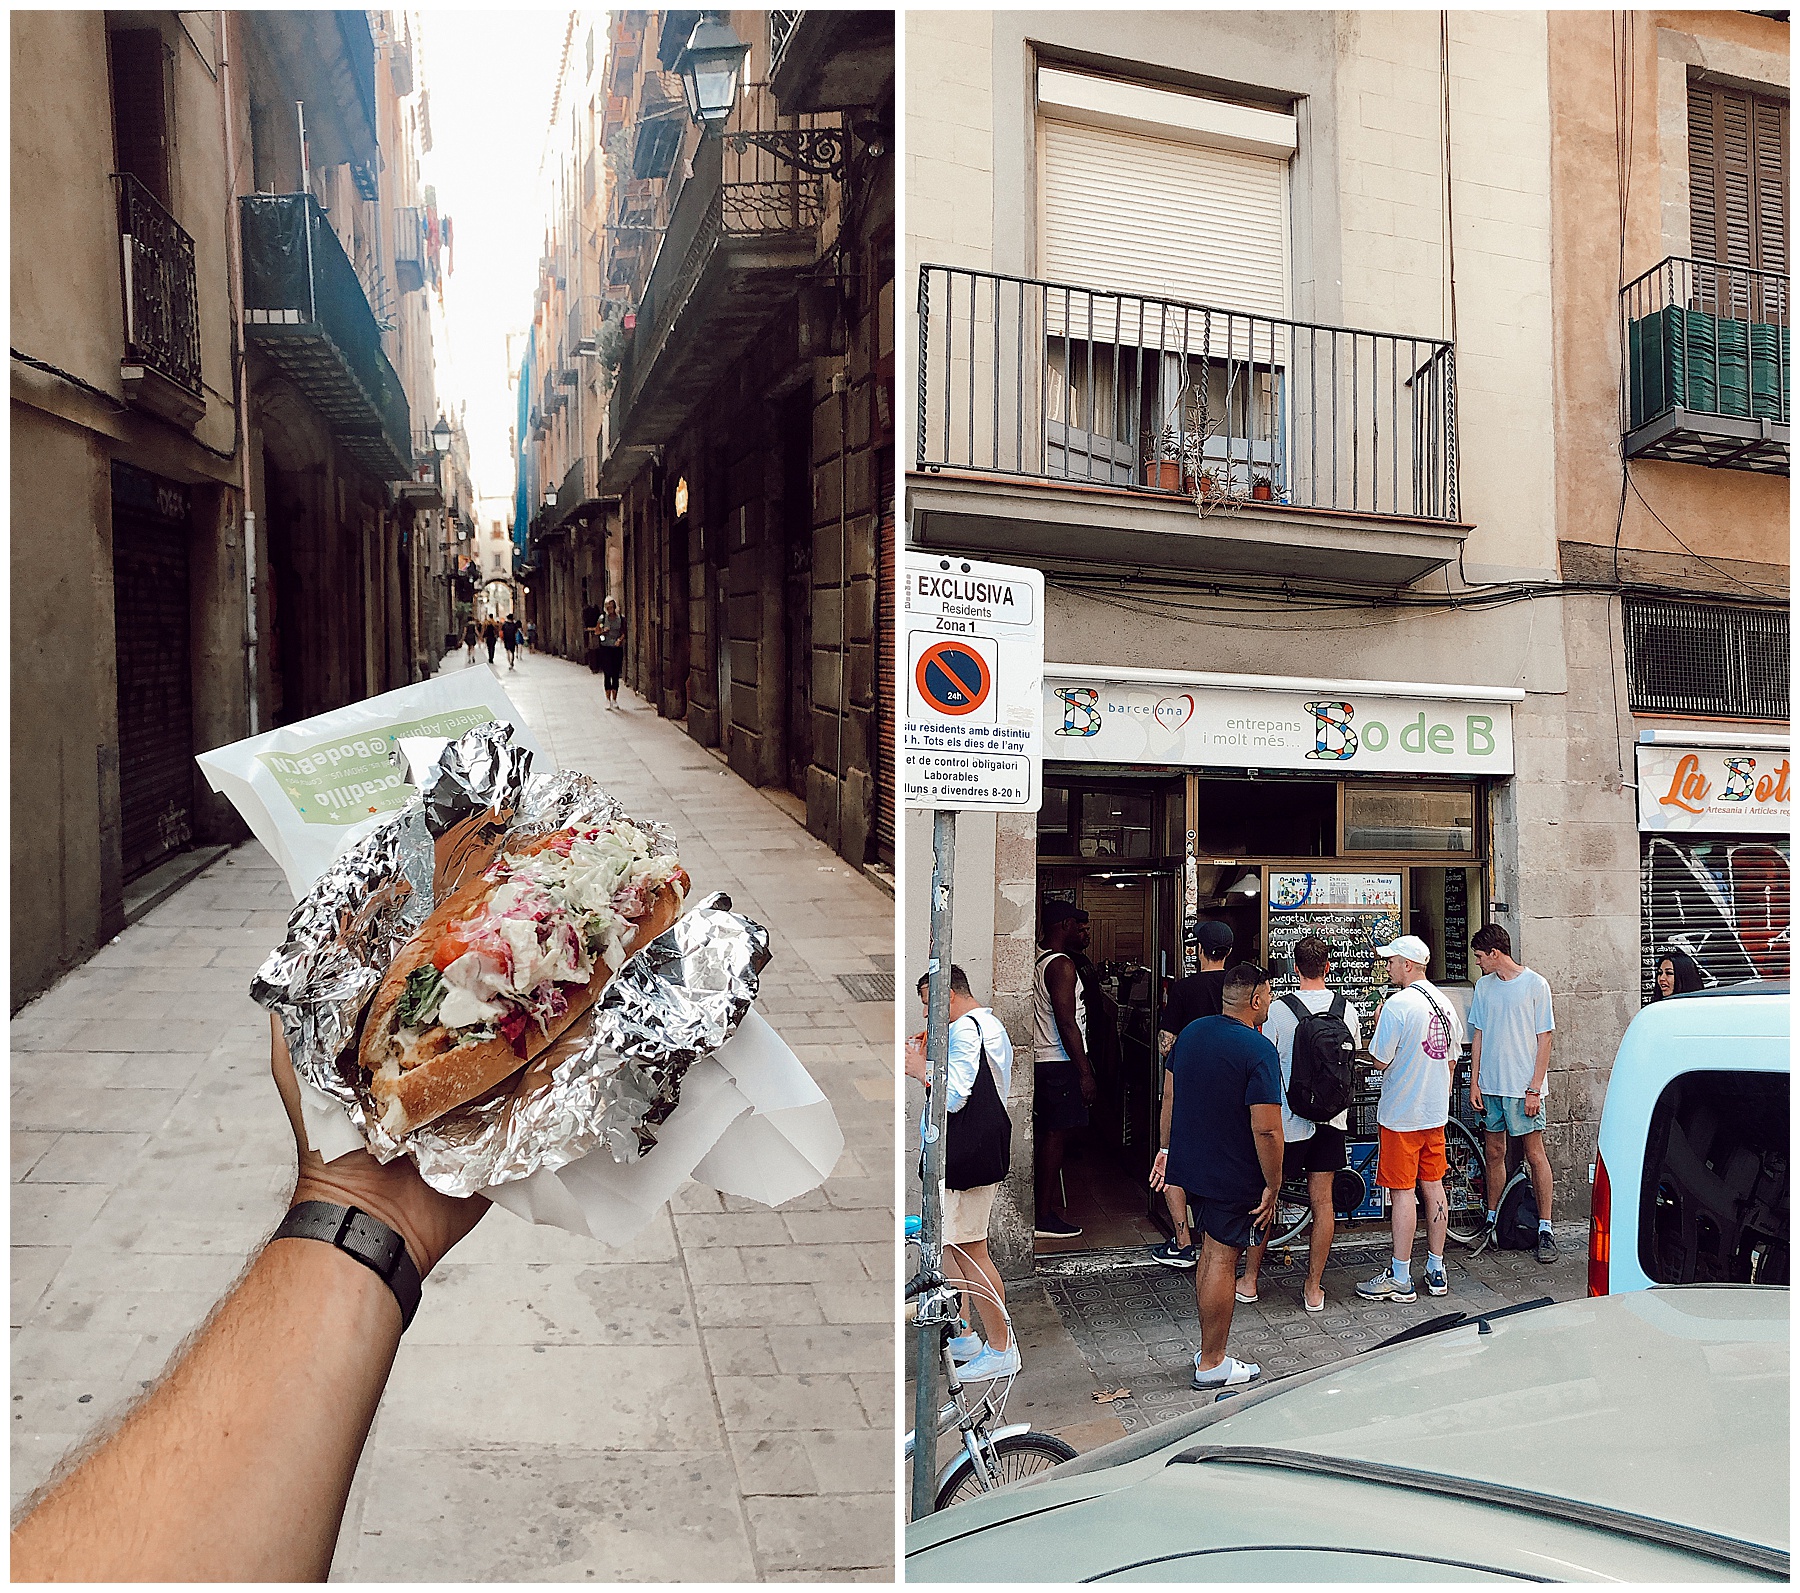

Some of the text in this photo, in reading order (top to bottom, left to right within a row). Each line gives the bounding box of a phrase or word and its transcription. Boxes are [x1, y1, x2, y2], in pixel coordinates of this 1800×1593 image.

[918, 575, 1015, 607] EXCLUSIVA
[942, 601, 992, 618] Residents
[935, 616, 975, 633] Zona 1
[947, 691, 962, 701] 24h
[1053, 687, 1183, 737] B barcelona
[920, 723, 966, 735] residents
[969, 727, 989, 736] amb
[992, 727, 1030, 739] distintiu
[1226, 718, 1301, 733] entrepans
[1303, 700, 1496, 761] Bo de B
[923, 735, 944, 746] Tots
[947, 737, 961, 747] els
[964, 738, 985, 749] dies
[987, 740, 999, 750] de
[1002, 740, 1024, 752] l'any
[1203, 732, 1300, 748] i molt més...
[270, 737, 388, 776] @BodeBCN
[918, 755, 931, 766] de
[934, 757, 969, 768] control
[972, 759, 1018, 772] obligatori
[924, 769, 979, 782] Laborables
[1659, 753, 1790, 814] La Bot
[314, 772, 402, 809] ocadillo
[932, 786, 938, 794] a
[941, 784, 989, 797] divendres
[992, 787, 1013, 798] 8-20
[1015, 788, 1021, 798] h
[1750, 806, 1778, 815] Articles
[1336, 925, 1362, 934] cheese
